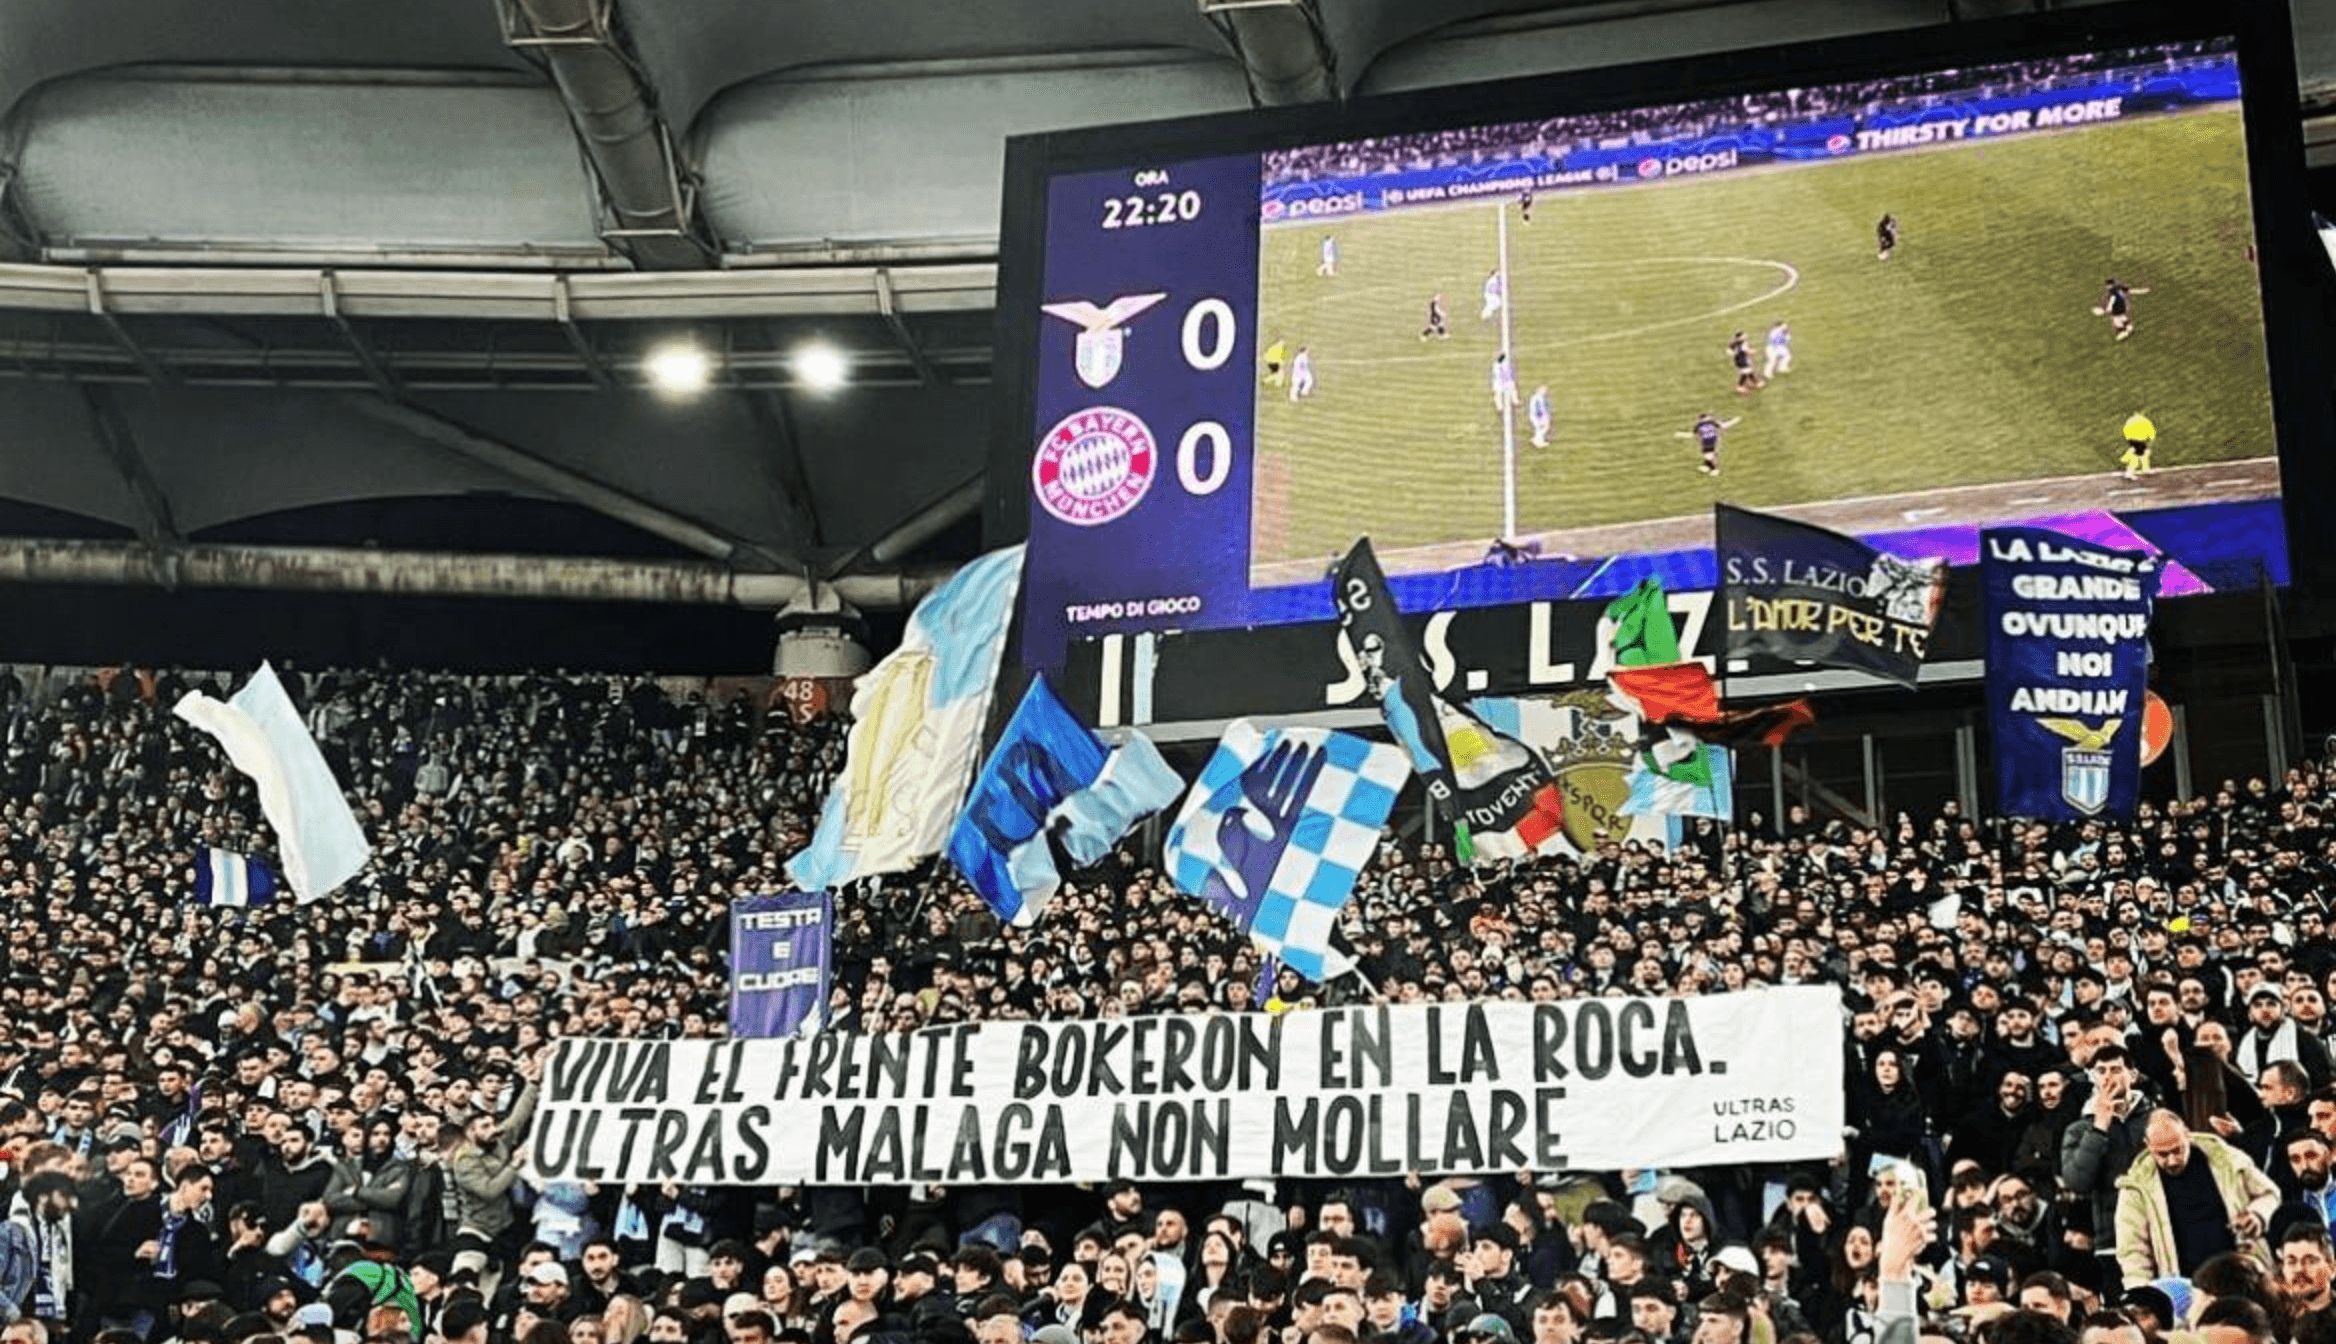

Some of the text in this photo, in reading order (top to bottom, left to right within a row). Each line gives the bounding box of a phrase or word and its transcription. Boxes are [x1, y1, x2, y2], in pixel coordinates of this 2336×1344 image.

[1856, 97, 2122, 150] THIRSTY FOR MORE
[1665, 147, 1738, 176] pepsi
[1135, 170, 1169, 187] ORA
[1406, 168, 1593, 201] UEFA CHAMPIONS LEAGUE
[1102, 190, 1201, 229] 22:20
[1289, 190, 1362, 217] pepsi
[1181, 298, 1236, 371] 0
[1176, 421, 1232, 495] 0
[1989, 538, 2034, 562] LA
[1784, 560, 1869, 598] LAZIO
[2012, 574, 2141, 600] GRANDE
[1066, 595, 1200, 622] TEMPO DI GIOCO
[1827, 604, 1883, 646] PER
[2057, 652, 2112, 677] NOI
[783, 680, 814, 701] 48
[1570, 787, 1624, 831] SPQR
[740, 907, 821, 930] TESTA
[773, 941, 791, 959] E
[739, 966, 819, 992] CUORE
[549, 1000, 1727, 1104] VIVA EL FRENTE BOKERON EN LA ROCA.
[1713, 1097, 1796, 1116] ULTRAS
[532, 1087, 1568, 1181] ULTRAS MALAGA NON MOLLARE
[1714, 1120, 1797, 1143] LAZIO
